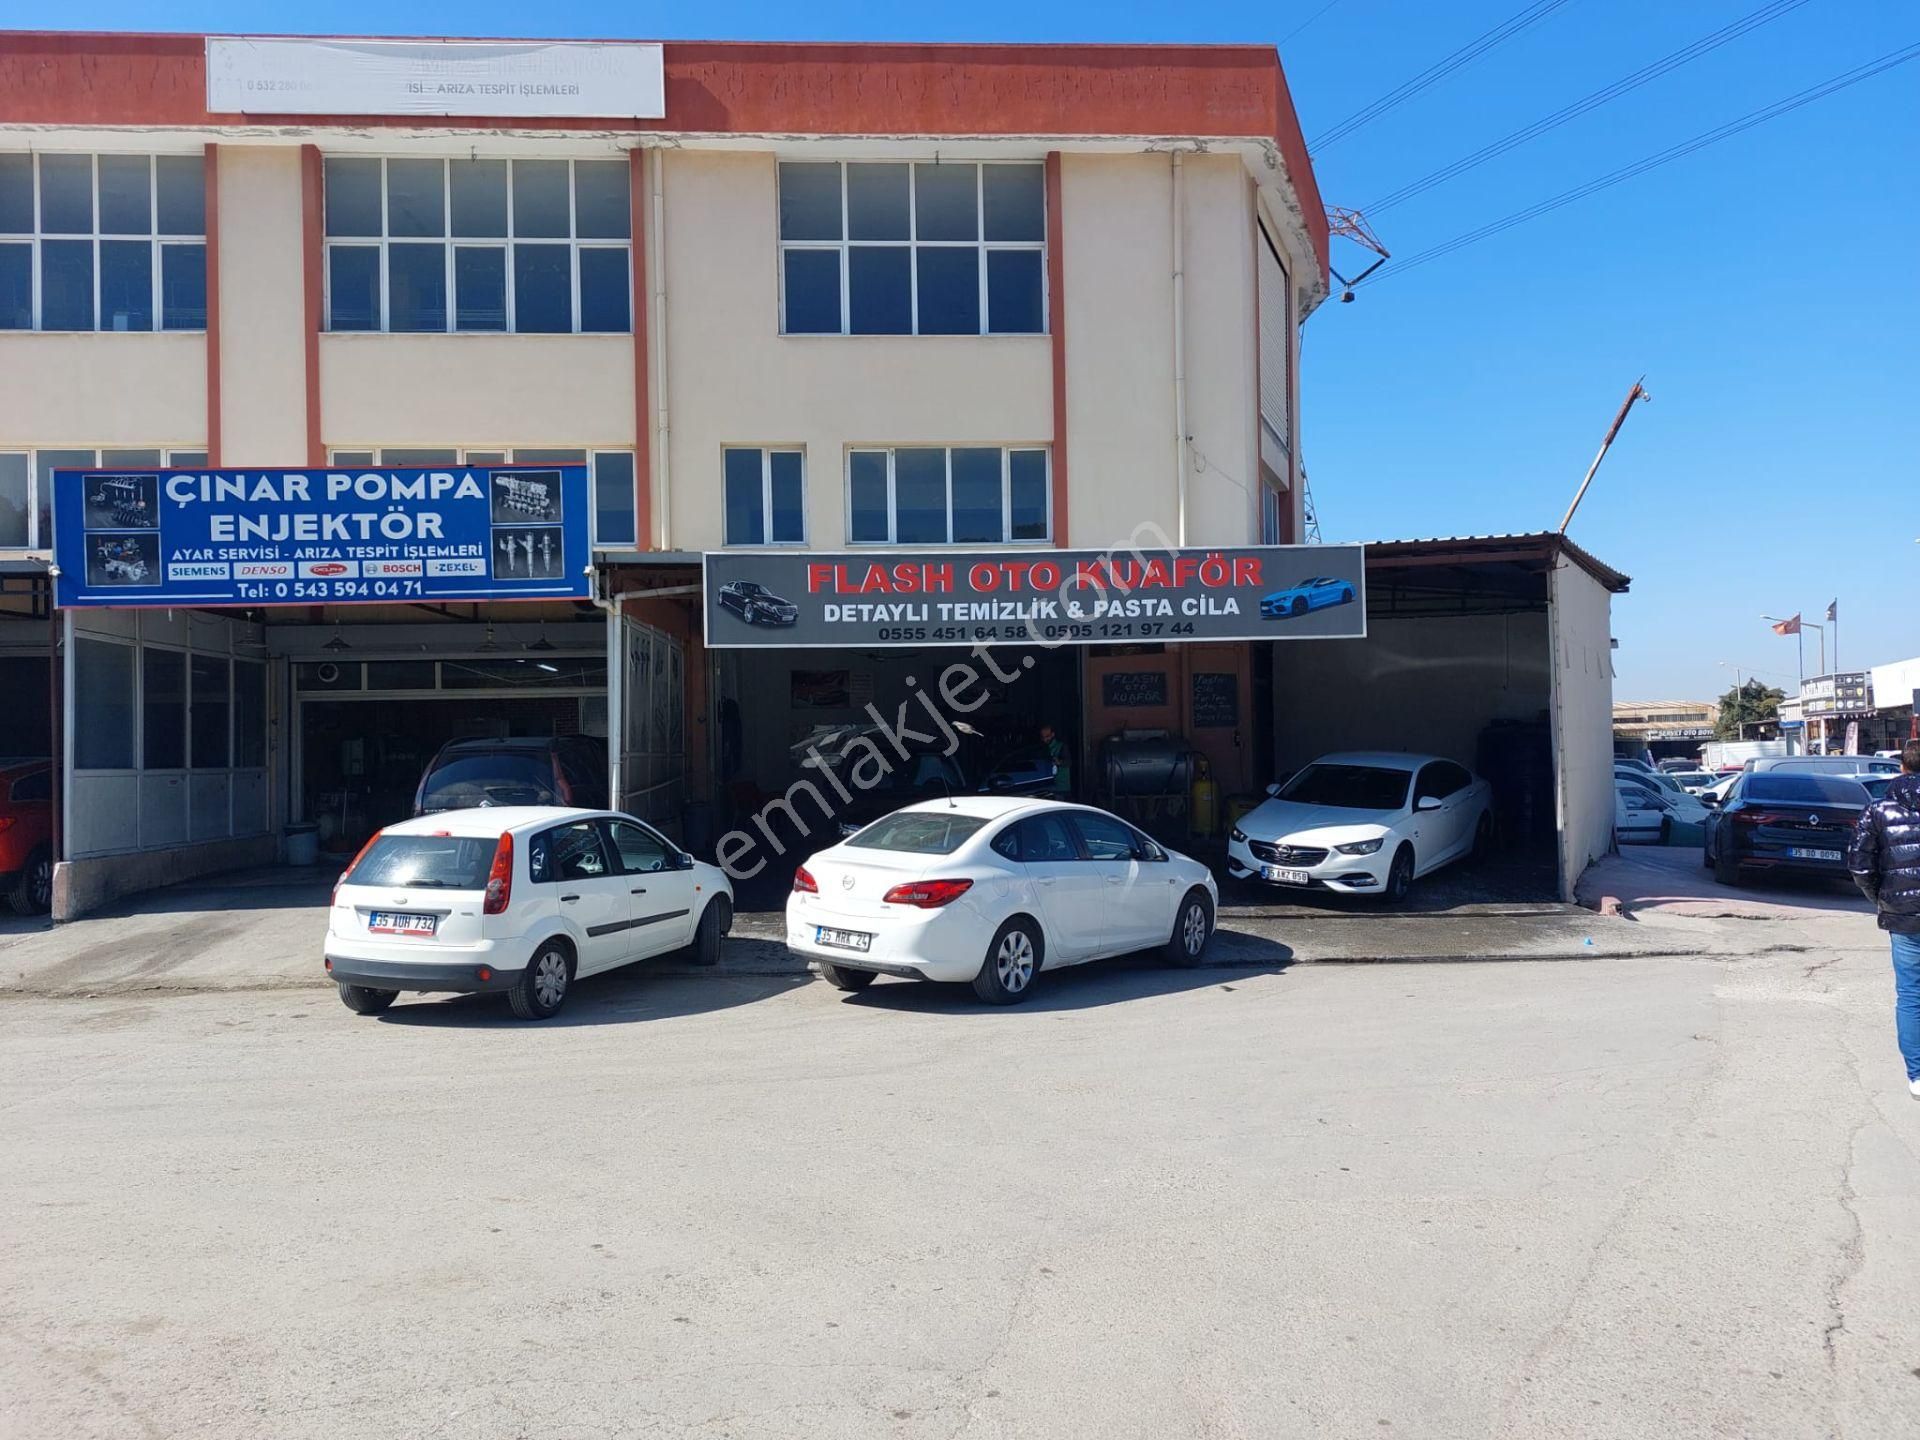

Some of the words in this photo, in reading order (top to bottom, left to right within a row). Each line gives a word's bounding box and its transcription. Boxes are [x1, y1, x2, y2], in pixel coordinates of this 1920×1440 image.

[437, 83, 475, 94] ARIZA
[479, 81, 516, 95] TESPİT
[165, 474, 311, 508] ÇINAR
[327, 472, 484, 501] POMPA
[210, 505, 445, 541] ENJEKTÖR
[172, 548, 213, 560] AYAR
[218, 545, 280, 560] SERVİSİ
[294, 547, 342, 559] ARIZA
[346, 543, 399, 558] TESPİT
[404, 542, 483, 559] İŞLEMLERİ
[171, 566, 226, 577] SIEMENS
[241, 565, 287, 575] DENSO
[383, 564, 421, 573] BOSCH
[807, 562, 953, 594] FLASH
[969, 561, 1061, 593] OTO
[1076, 552, 1264, 591] KUAFÖR
[237, 583, 269, 598] Tel:
[275, 583, 288, 598] 0
[294, 582, 328, 597] 543
[334, 581, 369, 597] 594
[374, 581, 399, 596] 04
[403, 580, 422, 595] 71
[824, 602, 928, 622] DETAYLI
[937, 597, 1058, 621] TEMİZLİK
[1066, 600, 1084, 618] &
[1093, 598, 1173, 618] PASTA
[1181, 594, 1240, 616] CİLA
[878, 627, 926, 640] 0555
[932, 626, 966, 639] 451
[974, 626, 997, 639] 64
[1004, 625, 1027, 639] 58
[1045, 624, 1092, 638] 0505
[1099, 623, 1133, 636] 121
[1140, 622, 1164, 635] 97
[1170, 622, 1194, 635] 44
[376, 914, 389, 927] 35
[414, 916, 434, 930] 732
